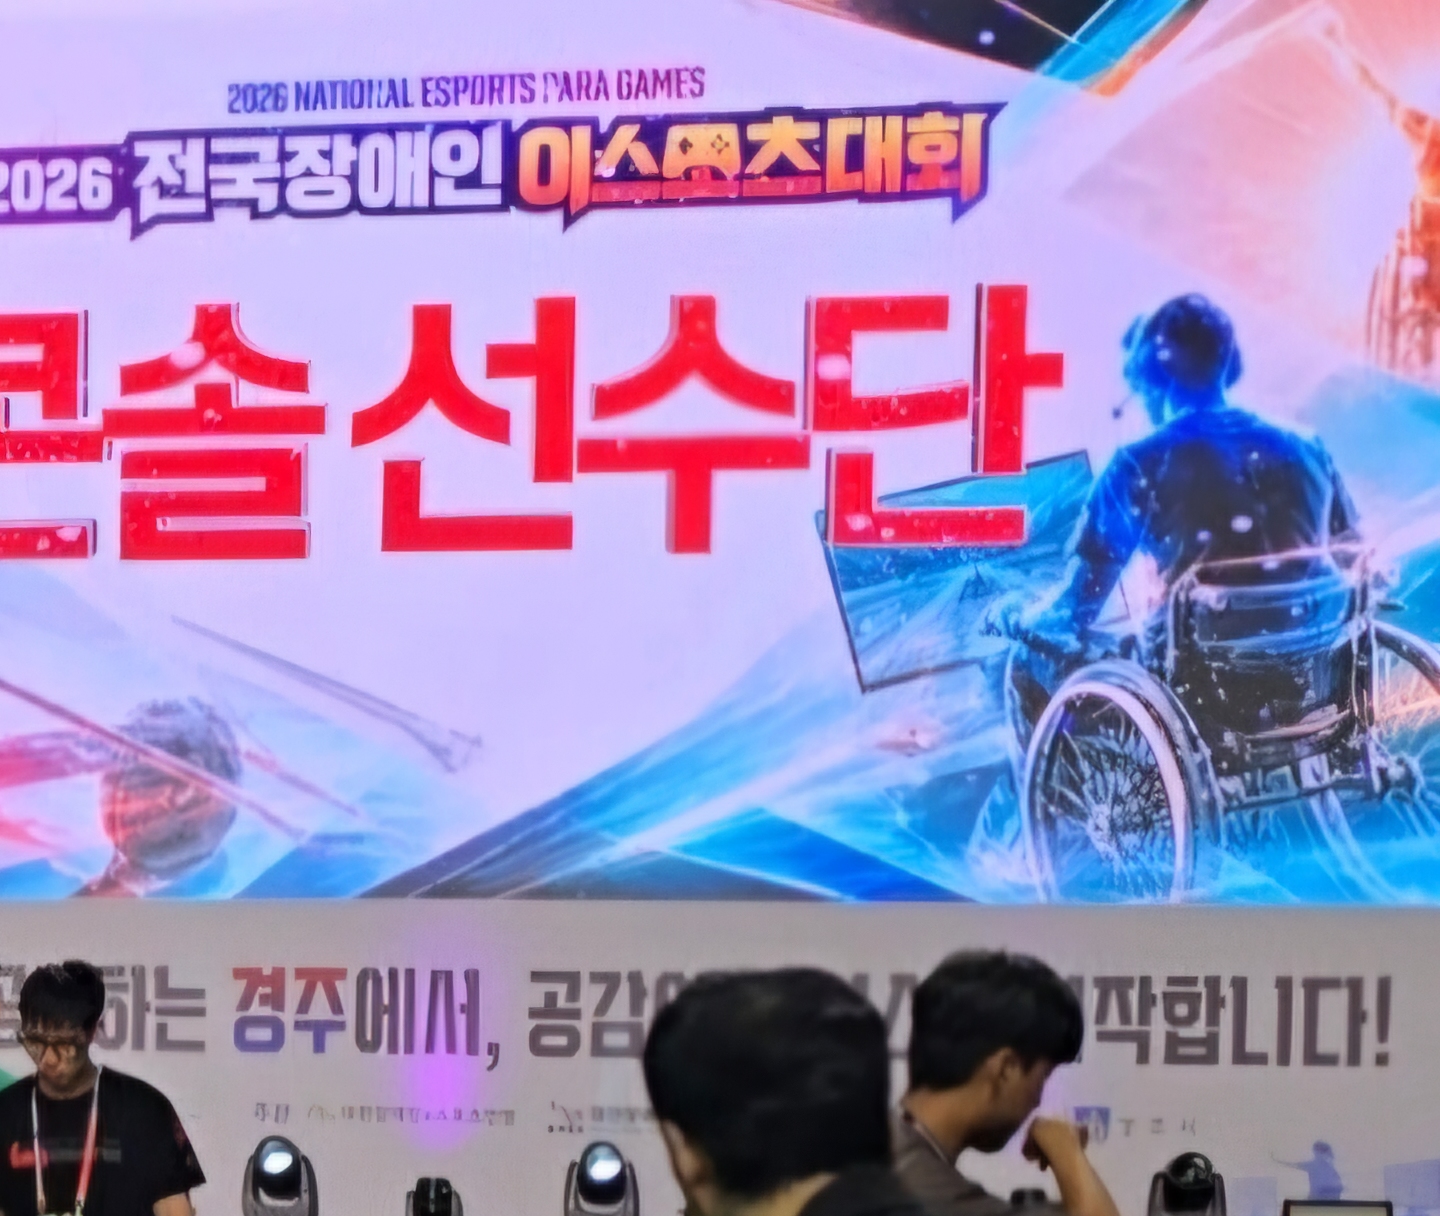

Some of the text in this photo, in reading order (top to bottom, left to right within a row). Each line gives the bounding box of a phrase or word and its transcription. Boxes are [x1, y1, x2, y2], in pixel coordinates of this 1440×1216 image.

[227, 65, 705, 112] 2026 NATIONAL ESPORTS PARA GAMES
[130, 123, 504, 219] 전국장애인
[516, 108, 990, 220] 이스포츠대회
[349, 280, 1066, 556] 선수단
[231, 965, 501, 1070] 경주에서,
[527, 967, 692, 1060] 공감
[1066, 973, 1393, 1068] 작합니다!
